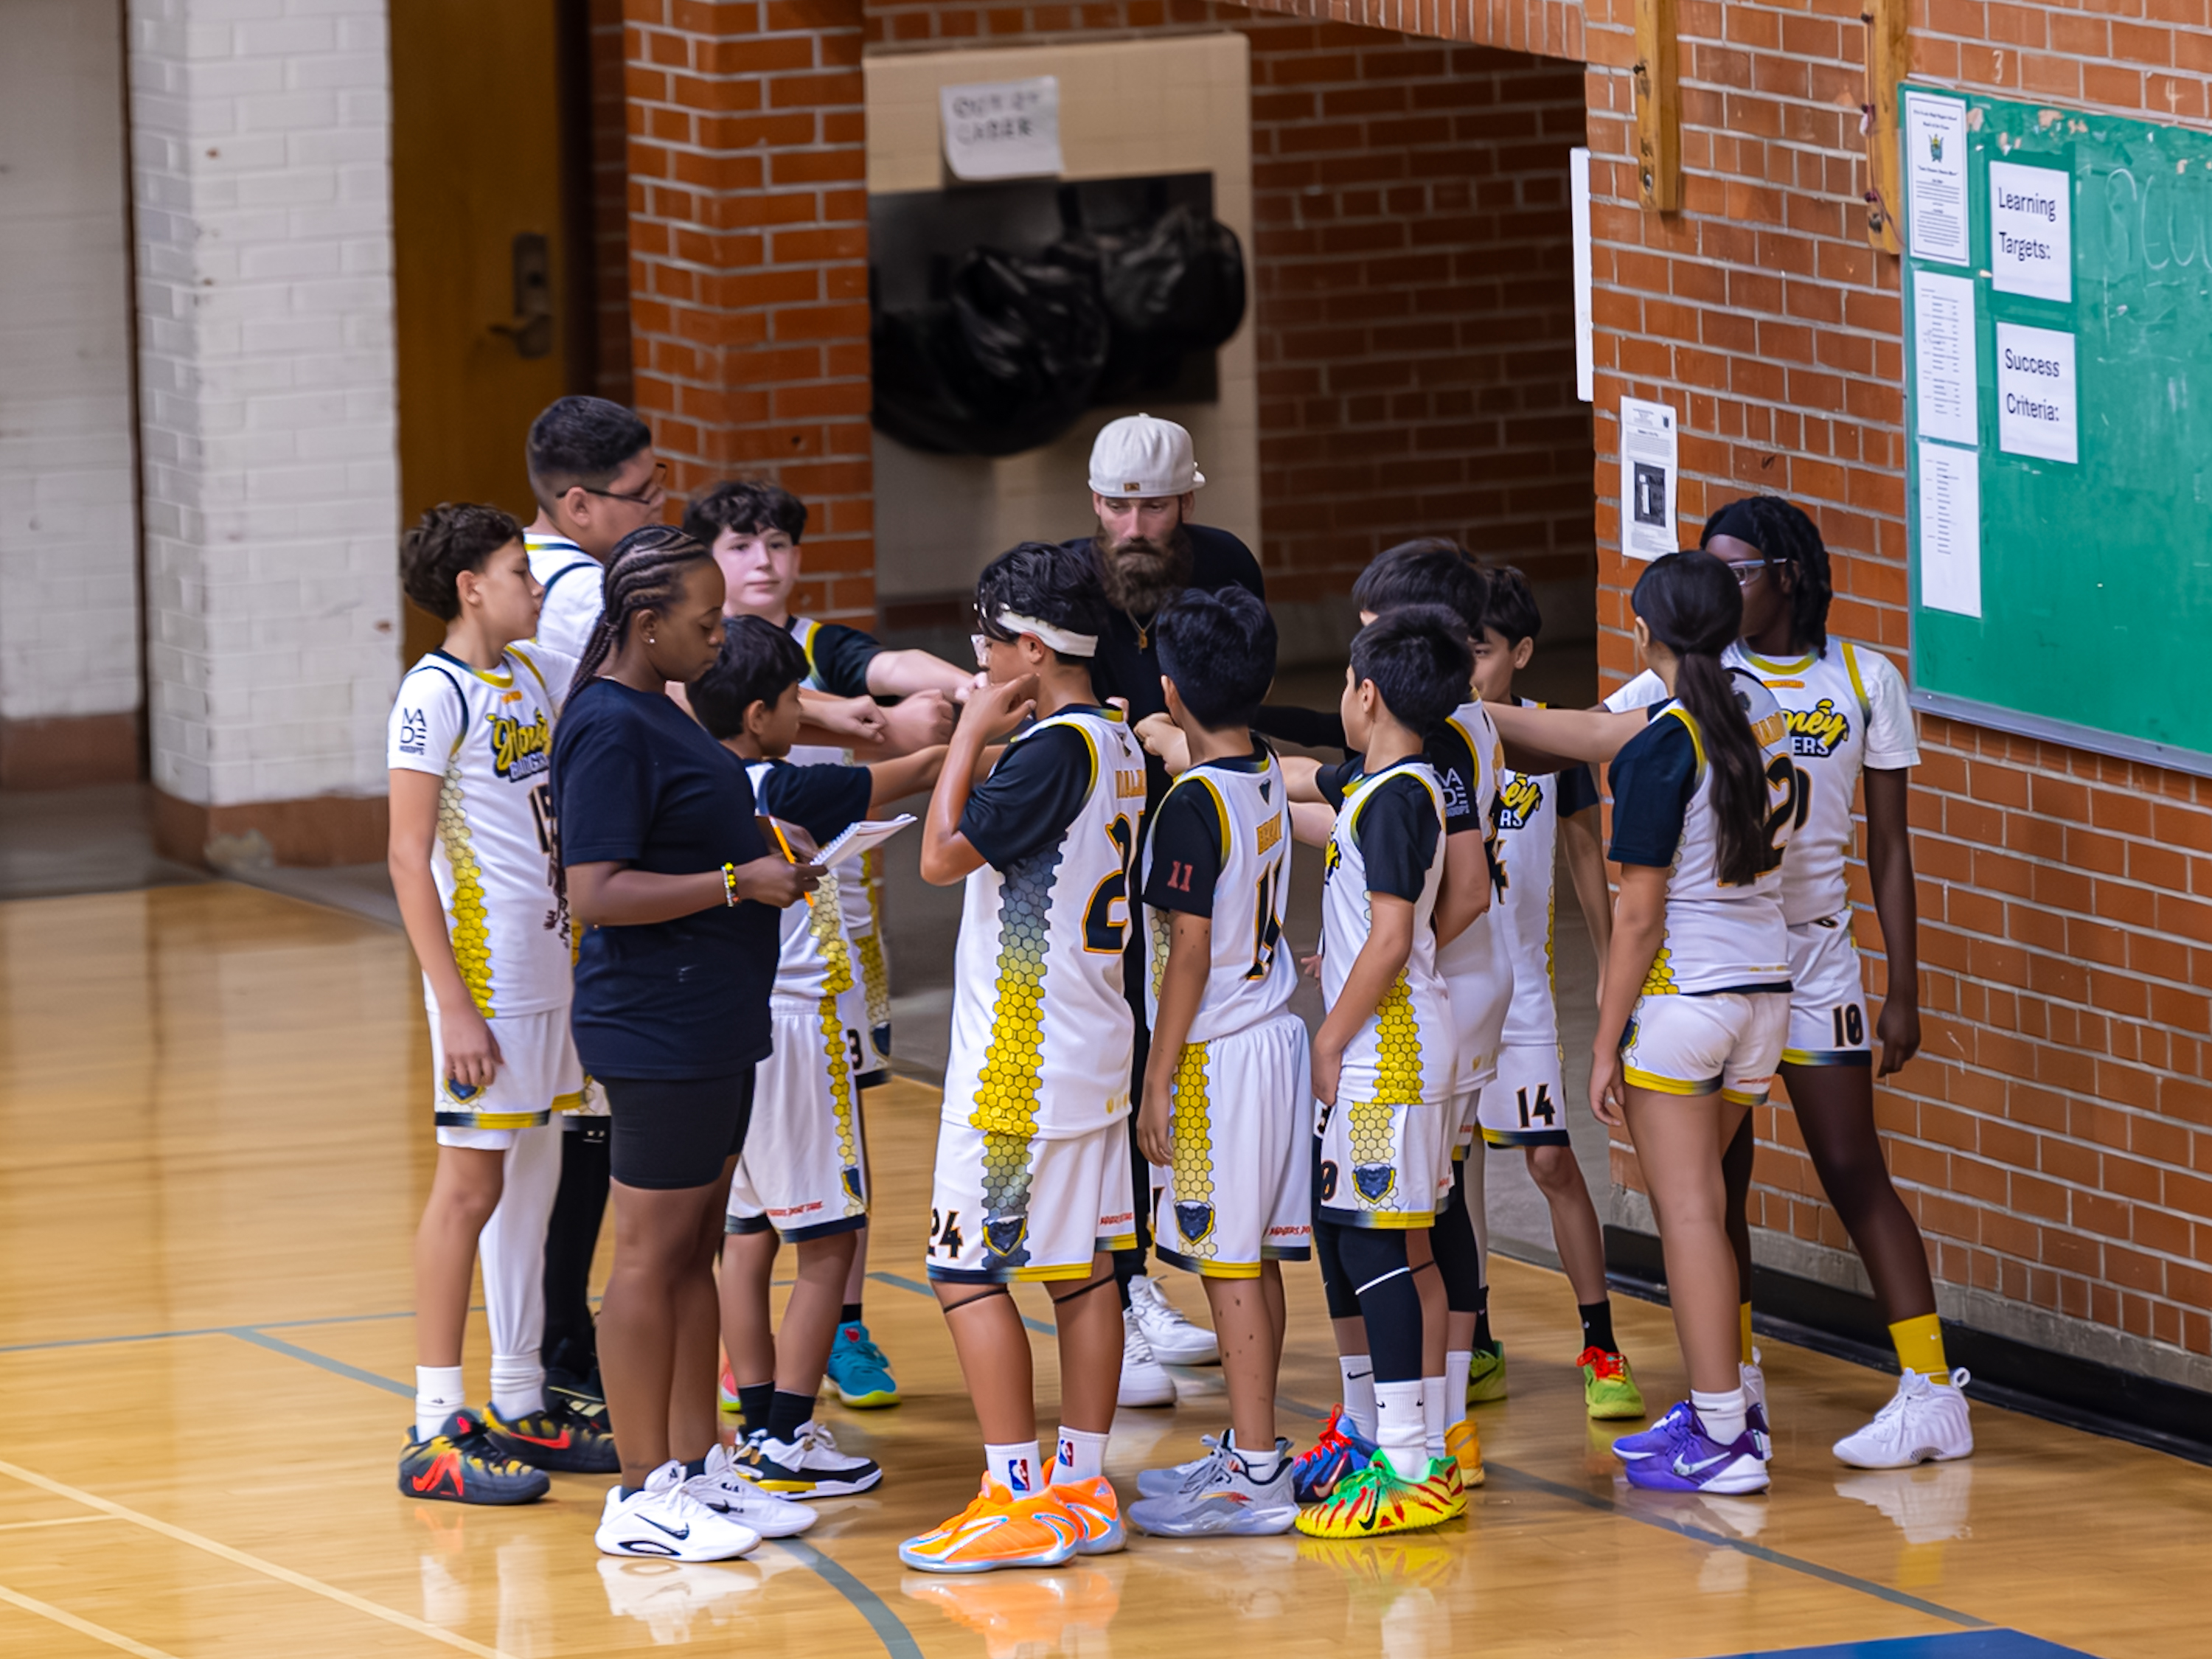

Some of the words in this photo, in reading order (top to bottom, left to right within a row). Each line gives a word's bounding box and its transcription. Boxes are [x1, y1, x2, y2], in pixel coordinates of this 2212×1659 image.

[1998, 187, 2056, 222] Learning
[1999, 232, 2051, 261] Targets:
[2005, 348, 2059, 377] Success
[2007, 393, 2059, 421] Criteria:
[1167, 860, 1193, 892] 11
[1516, 1083, 1556, 1128] 14
